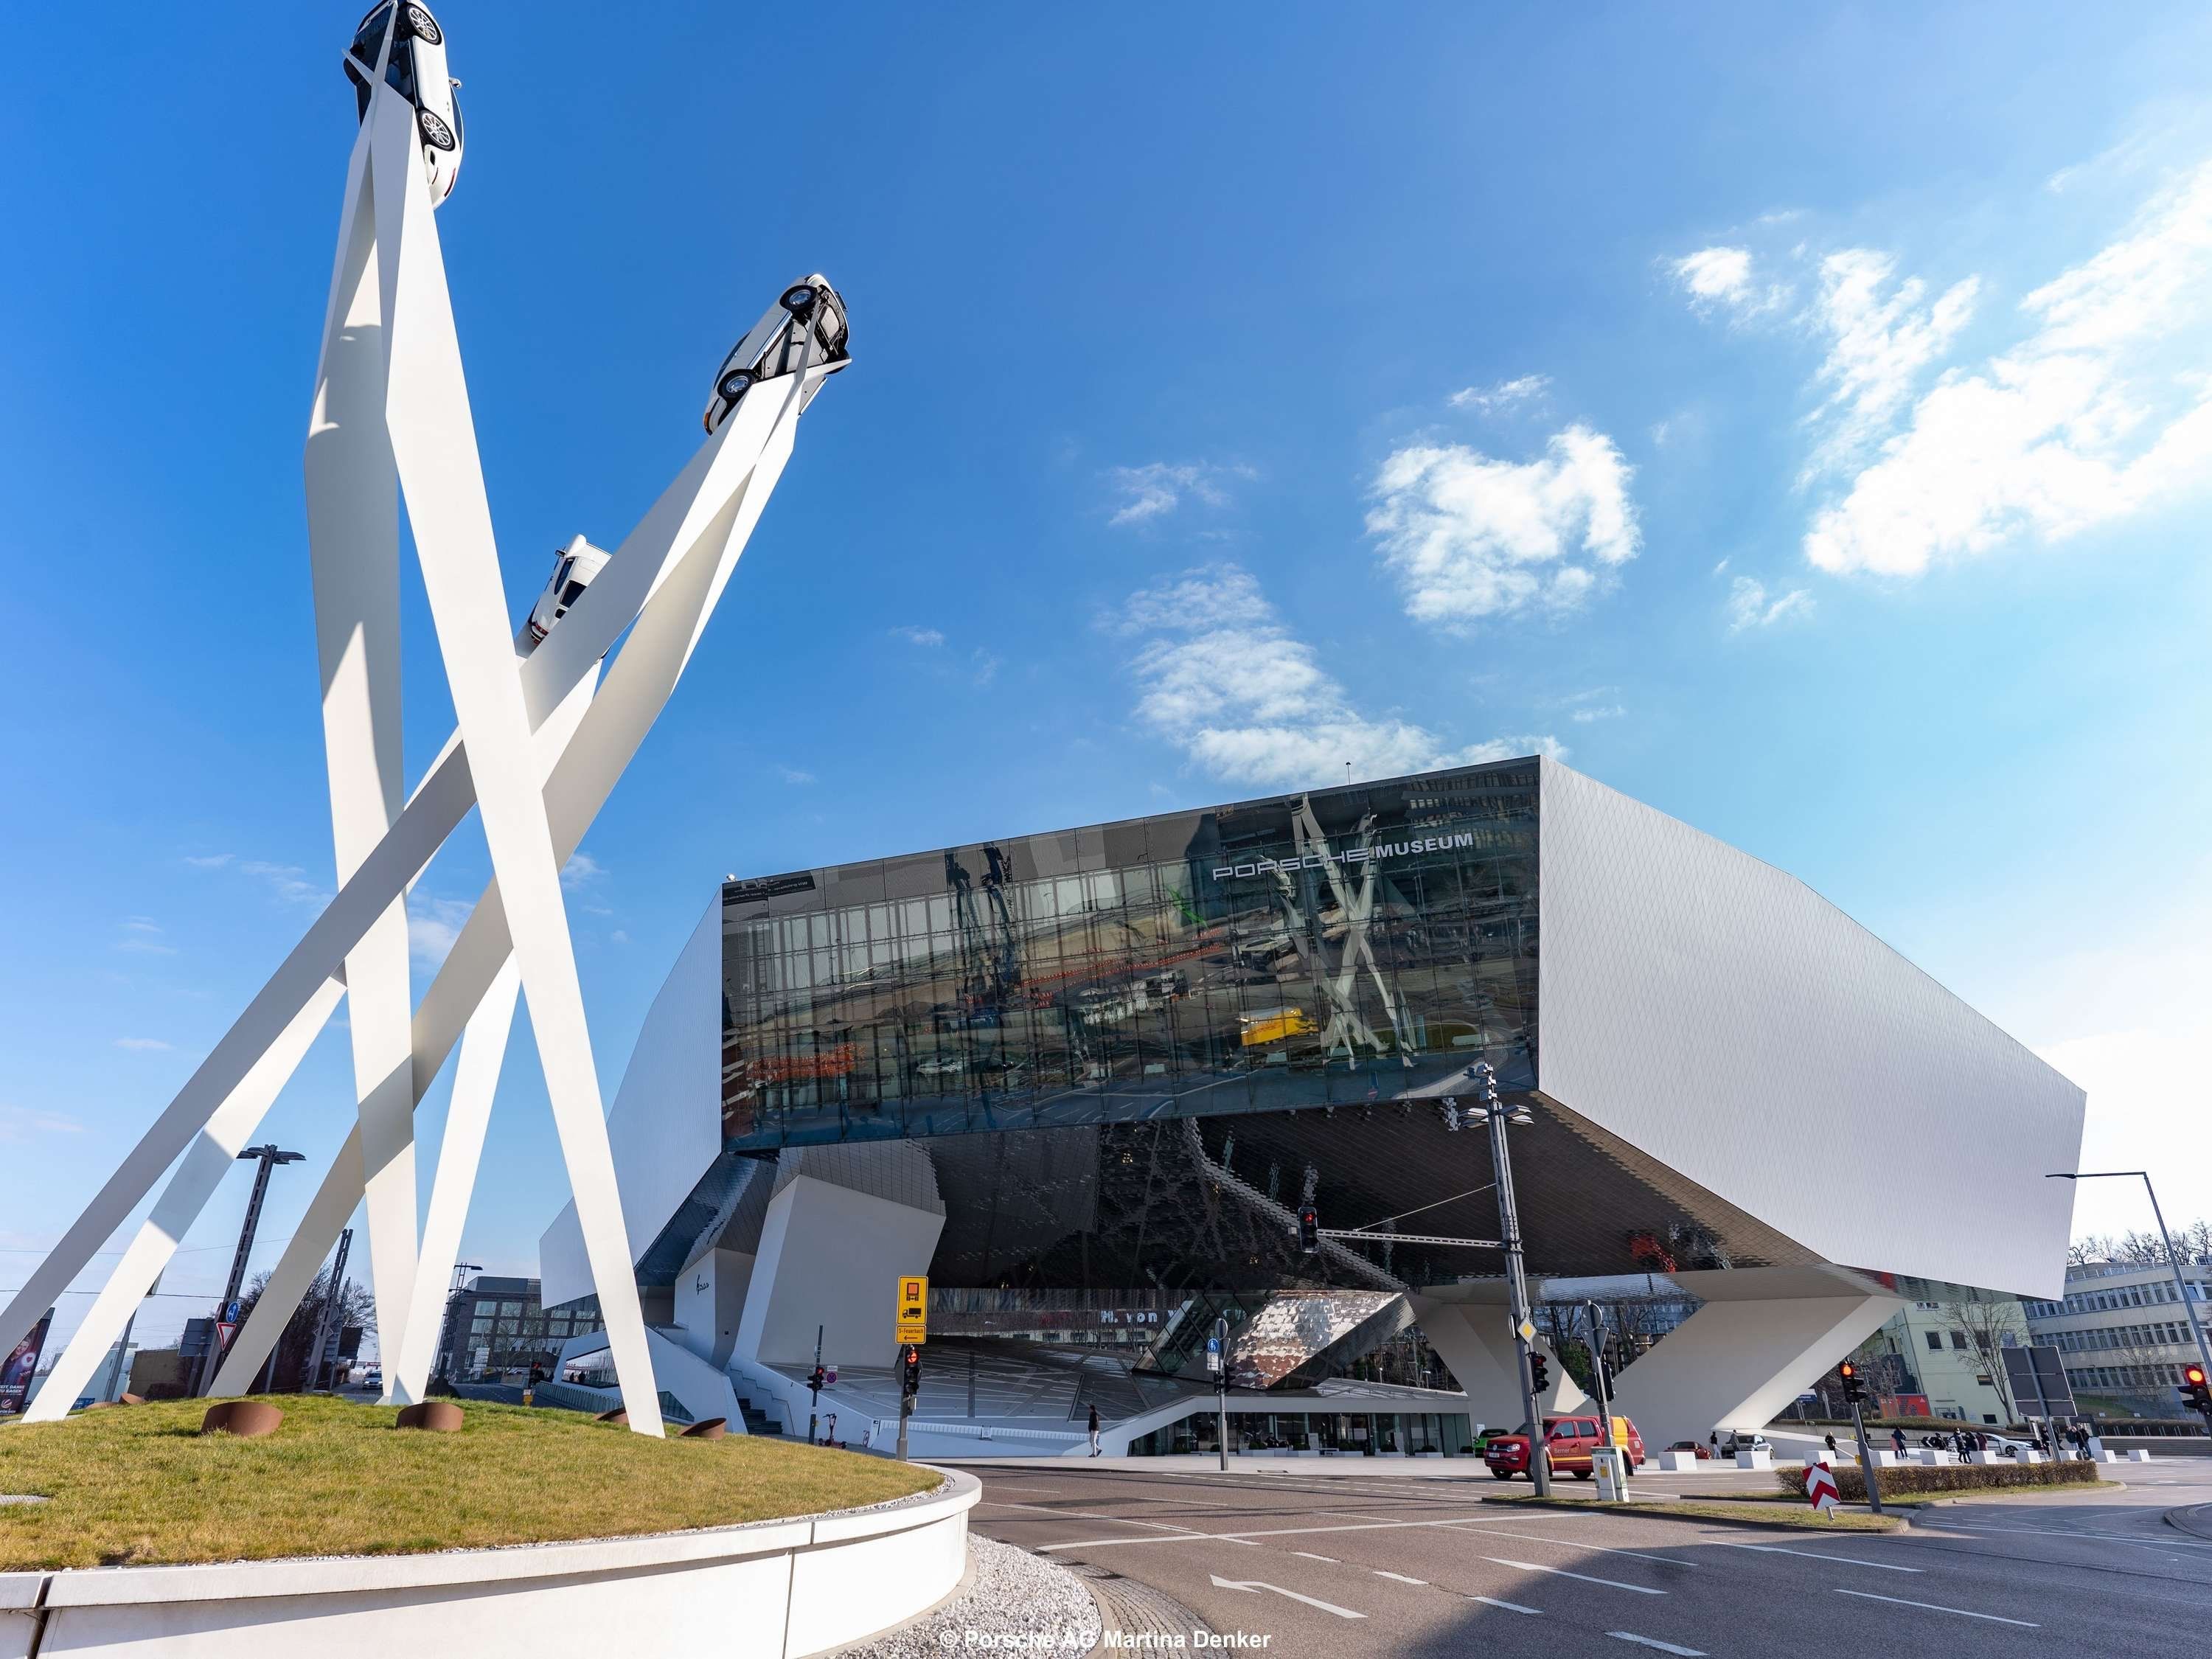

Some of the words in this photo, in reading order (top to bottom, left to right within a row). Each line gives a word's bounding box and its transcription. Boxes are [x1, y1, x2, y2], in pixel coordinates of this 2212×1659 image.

[1212, 847, 1370, 880] PORSCHE
[1375, 832, 1474, 858] MUSEUM
[1126, 1312, 1158, 1323] von
